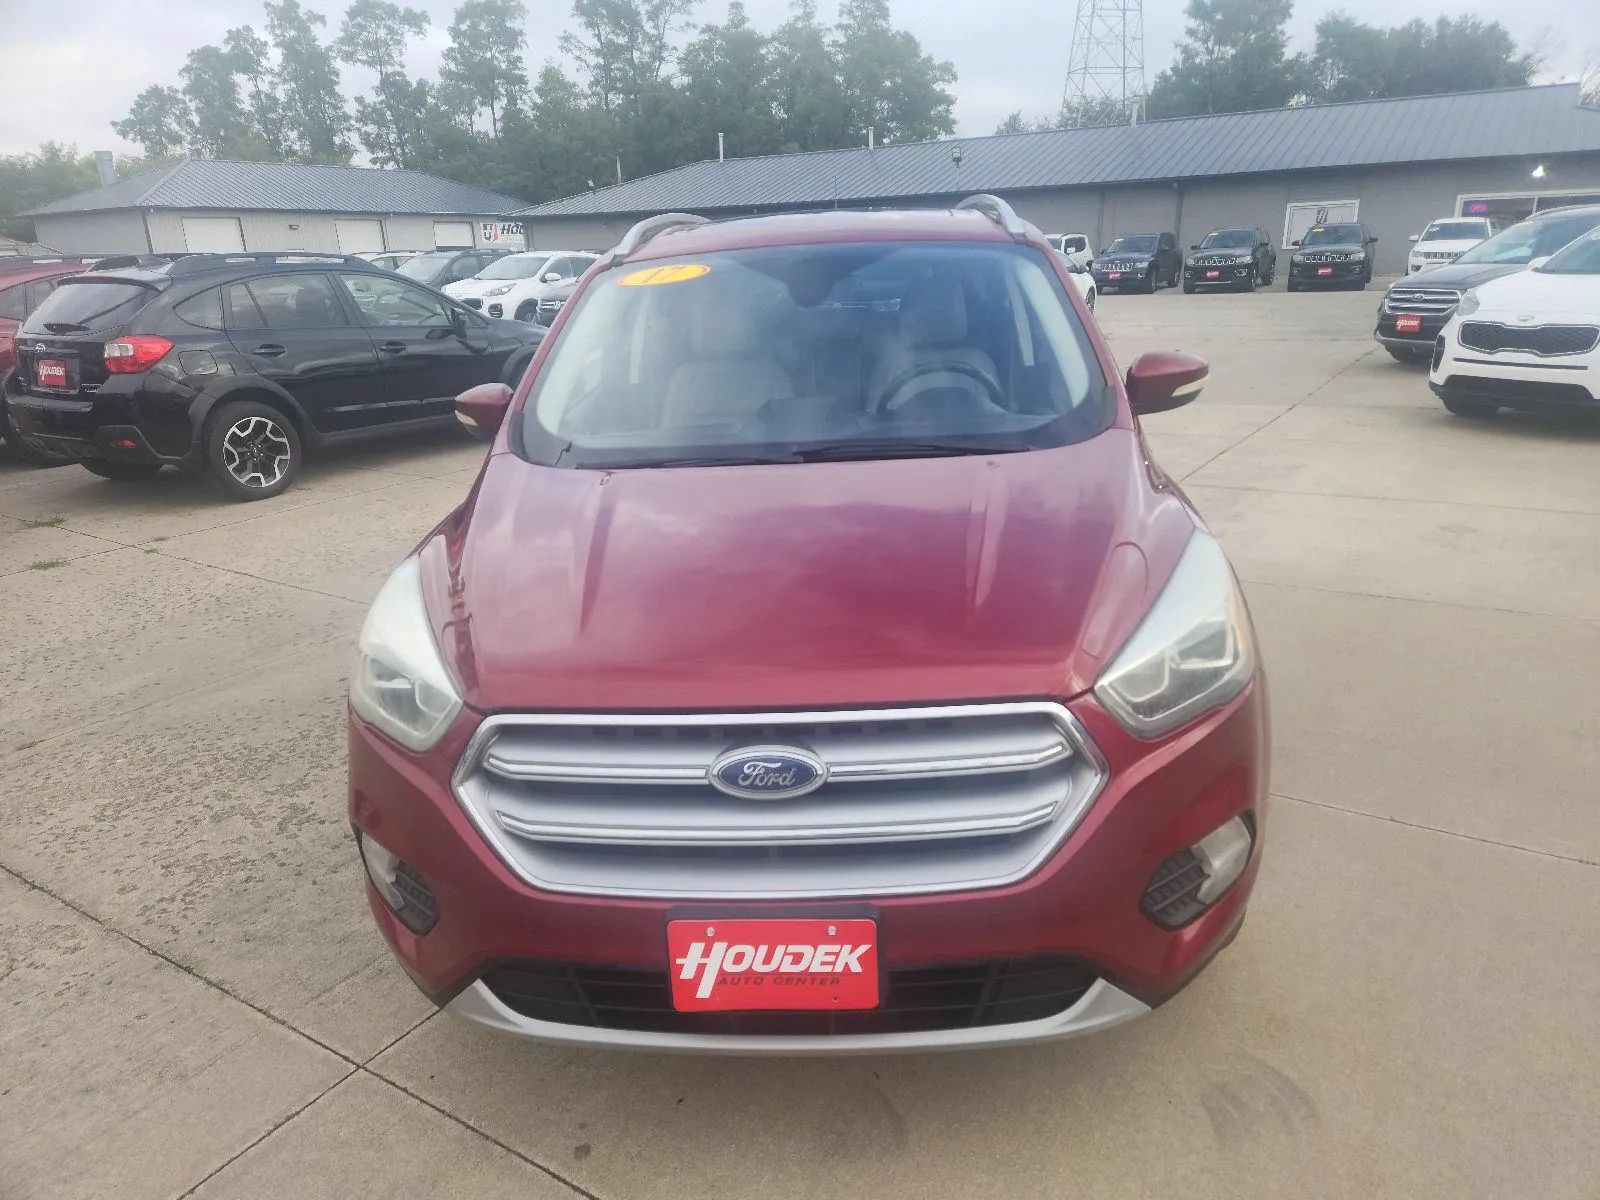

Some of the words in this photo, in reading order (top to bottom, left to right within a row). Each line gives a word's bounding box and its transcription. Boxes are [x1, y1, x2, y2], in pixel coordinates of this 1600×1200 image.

[39, 365, 65, 381] HOUDEK
[738, 761, 797, 786] Ford
[676, 942, 872, 999] HOUDEK
[718, 977, 764, 986] AUTO
[773, 976, 840, 986] CENTER
